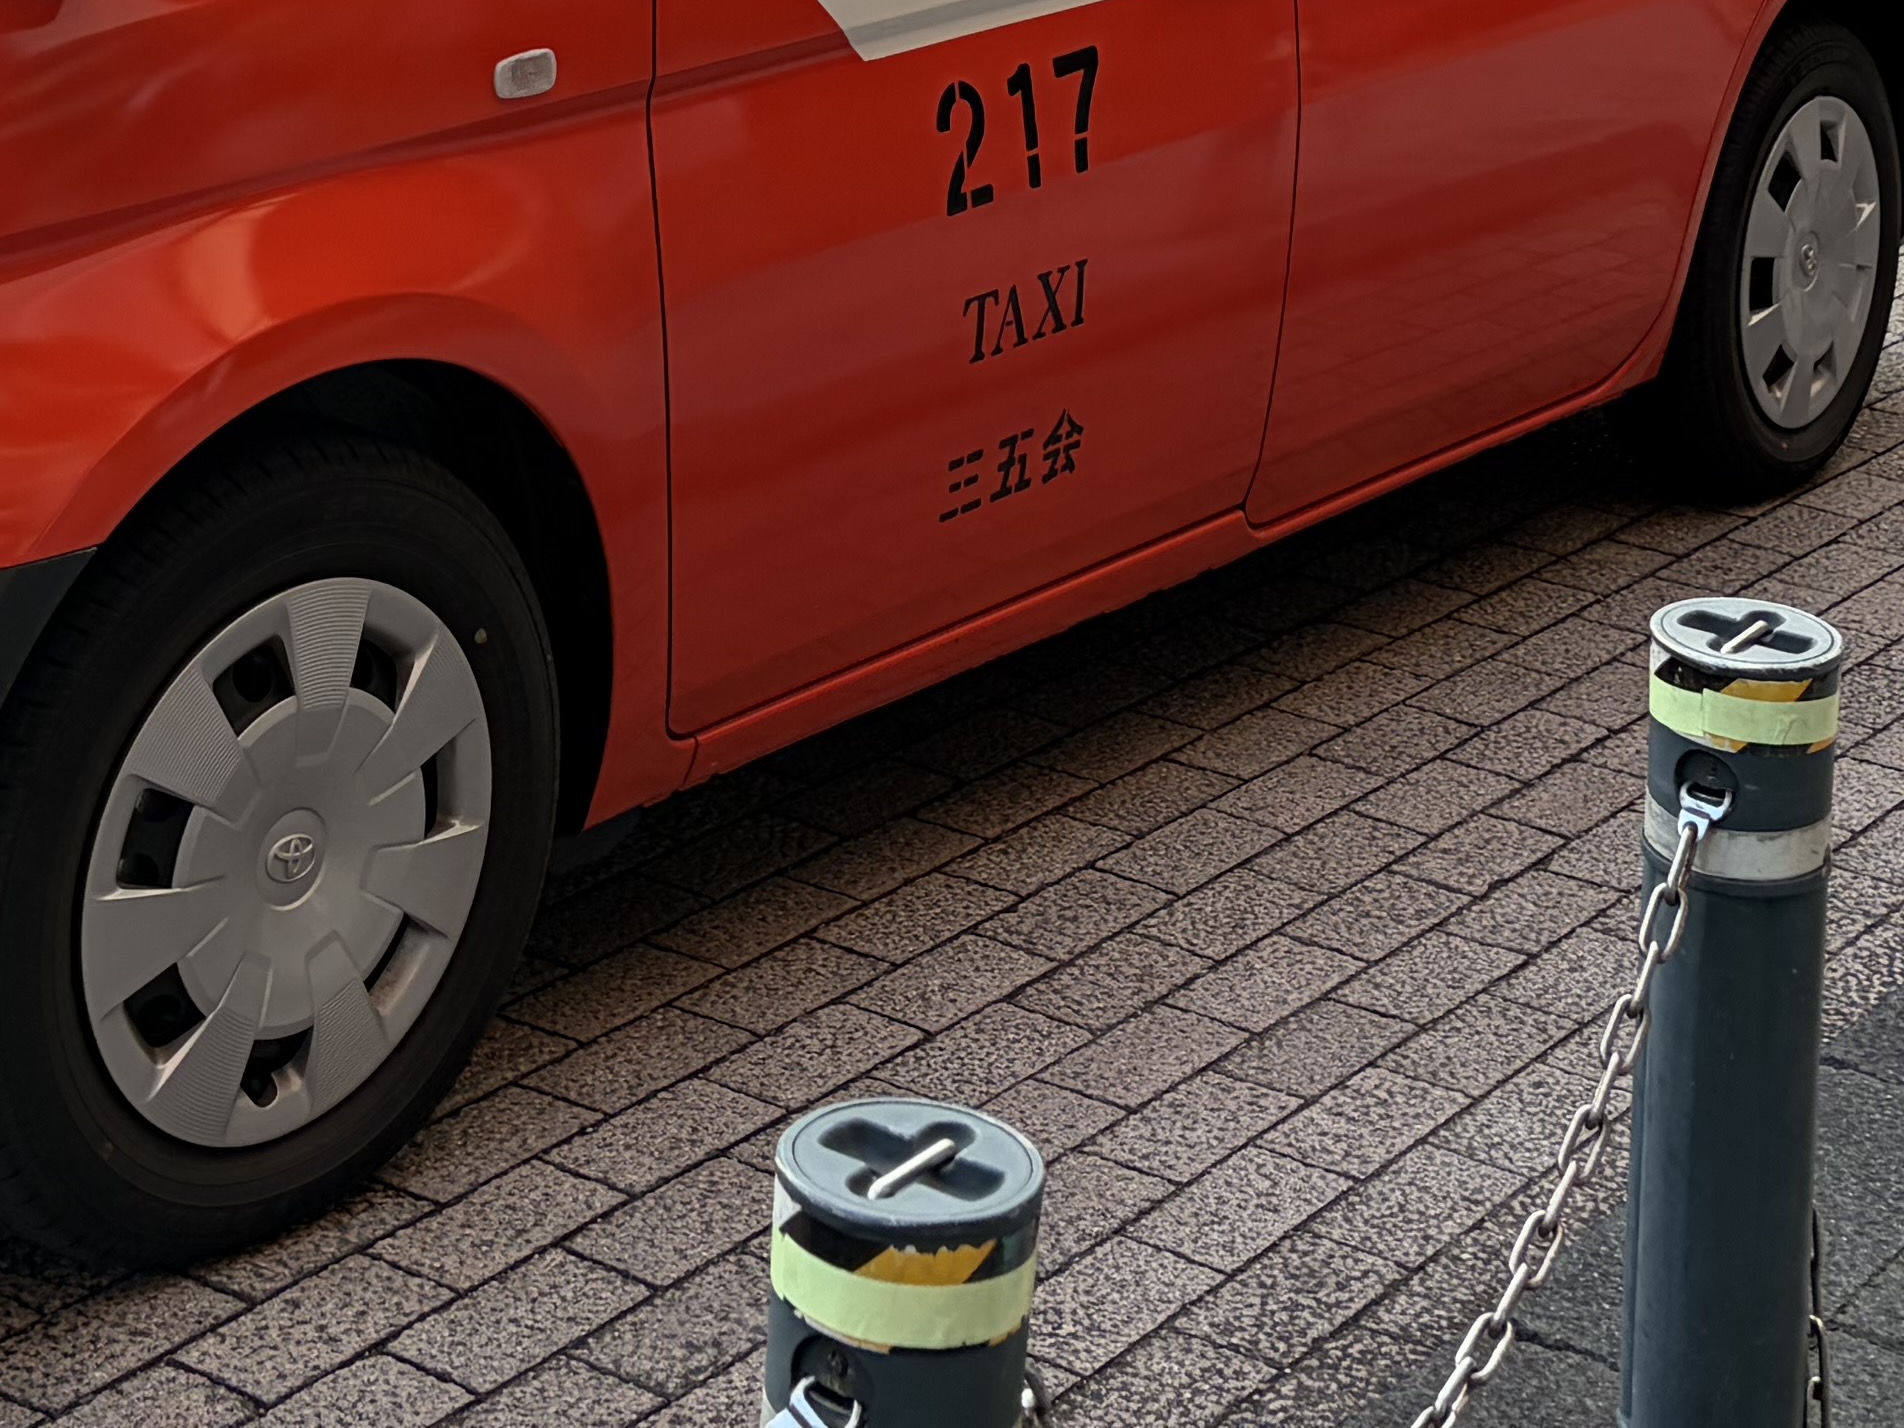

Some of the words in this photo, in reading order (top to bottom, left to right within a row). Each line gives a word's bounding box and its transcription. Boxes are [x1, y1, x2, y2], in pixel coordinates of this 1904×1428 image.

[935, 45, 1100, 218] 217
[962, 257, 1089, 366] TAXI
[938, 408, 1086, 524] 三五会
